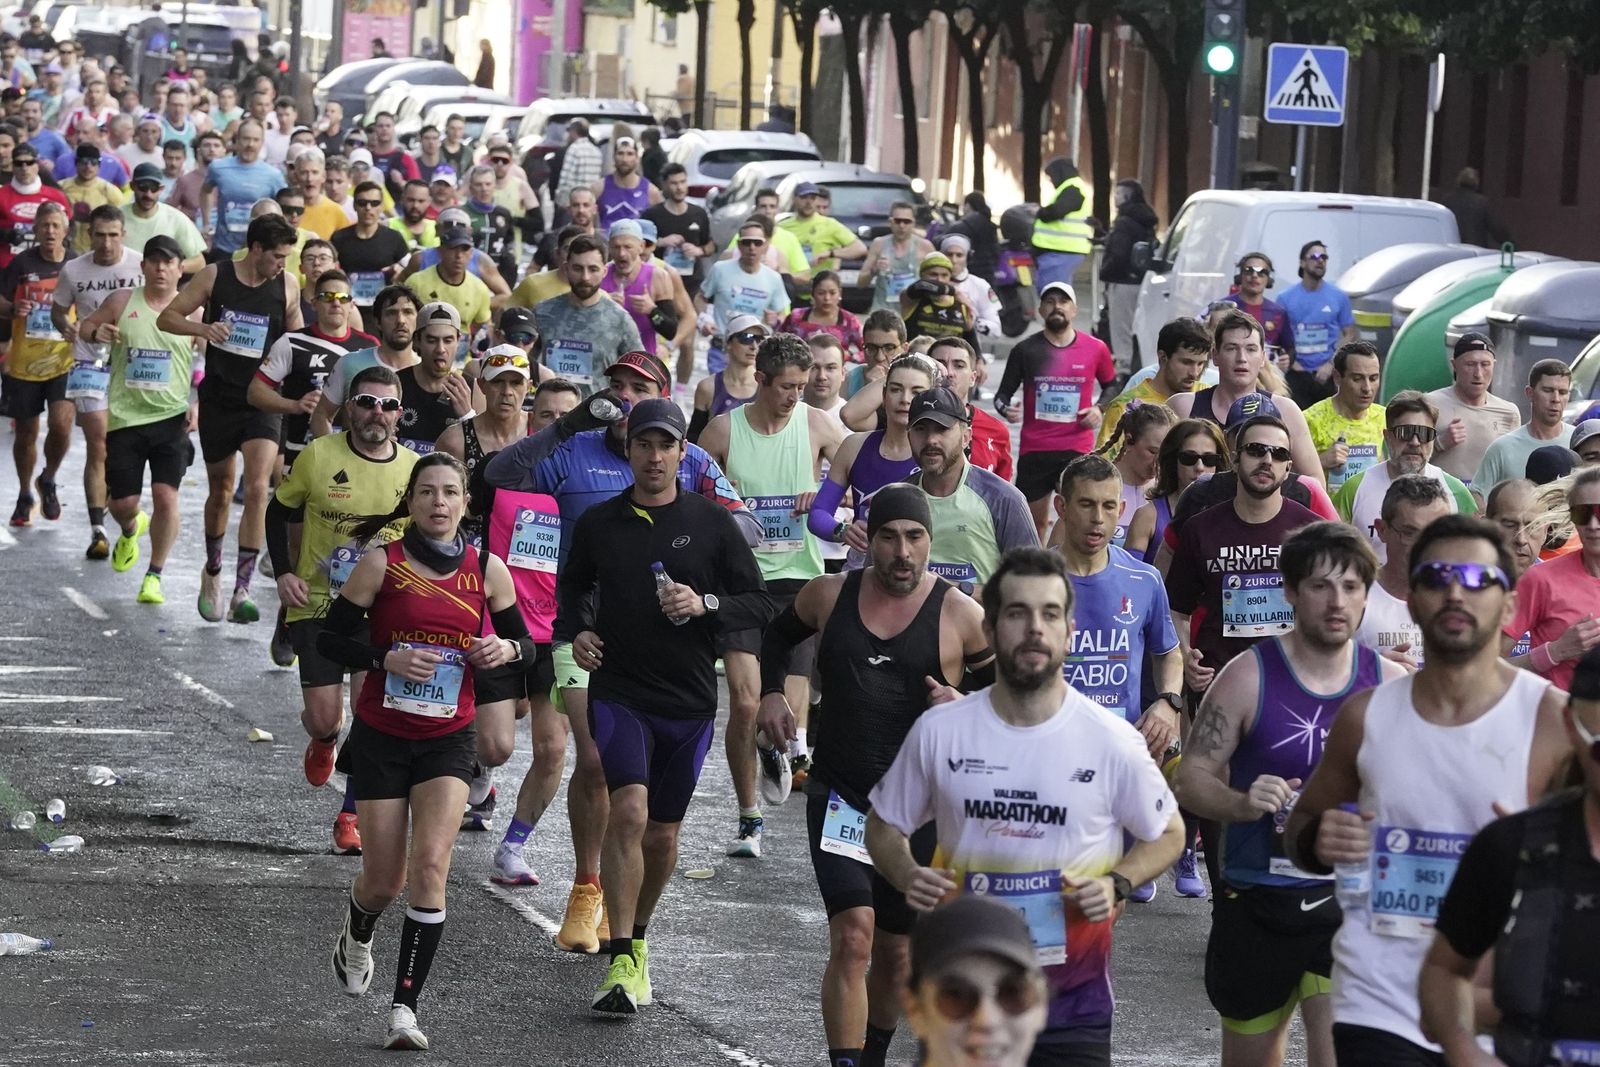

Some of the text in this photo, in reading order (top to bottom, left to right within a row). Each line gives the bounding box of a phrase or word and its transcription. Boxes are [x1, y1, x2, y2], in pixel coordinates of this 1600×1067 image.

[238, 315, 263, 324] ZURICH
[563, 342, 589, 350] ZURICH
[141, 350, 168, 359] ZURICH
[133, 370, 162, 379] GARRY
[1044, 403, 1059, 412] TED
[418, 444, 436, 452] ZUR
[1349, 448, 1374, 456] ZURICH
[761, 499, 796, 507] ZURICH
[538, 515, 561, 527] ZURI
[763, 516, 781, 524] 7602
[537, 532, 554, 542] 9338
[764, 527, 790, 538] ABLO
[931, 567, 969, 577] ZURICH
[1245, 577, 1283, 587] ZURICH
[1247, 597, 1267, 605] 8904
[1225, 613, 1246, 622] ALEX
[1070, 629, 1129, 653] TALIA
[1378, 632, 1424, 646] BRANE-C
[403, 682, 444, 700] SOFIA
[994, 789, 1038, 800] VALENCIA
[964, 800, 1067, 826] MARATHON
[1416, 837, 1467, 854] ZURIC
[995, 877, 1050, 892] ZURICH
[1373, 889, 1420, 911] JOÃO
